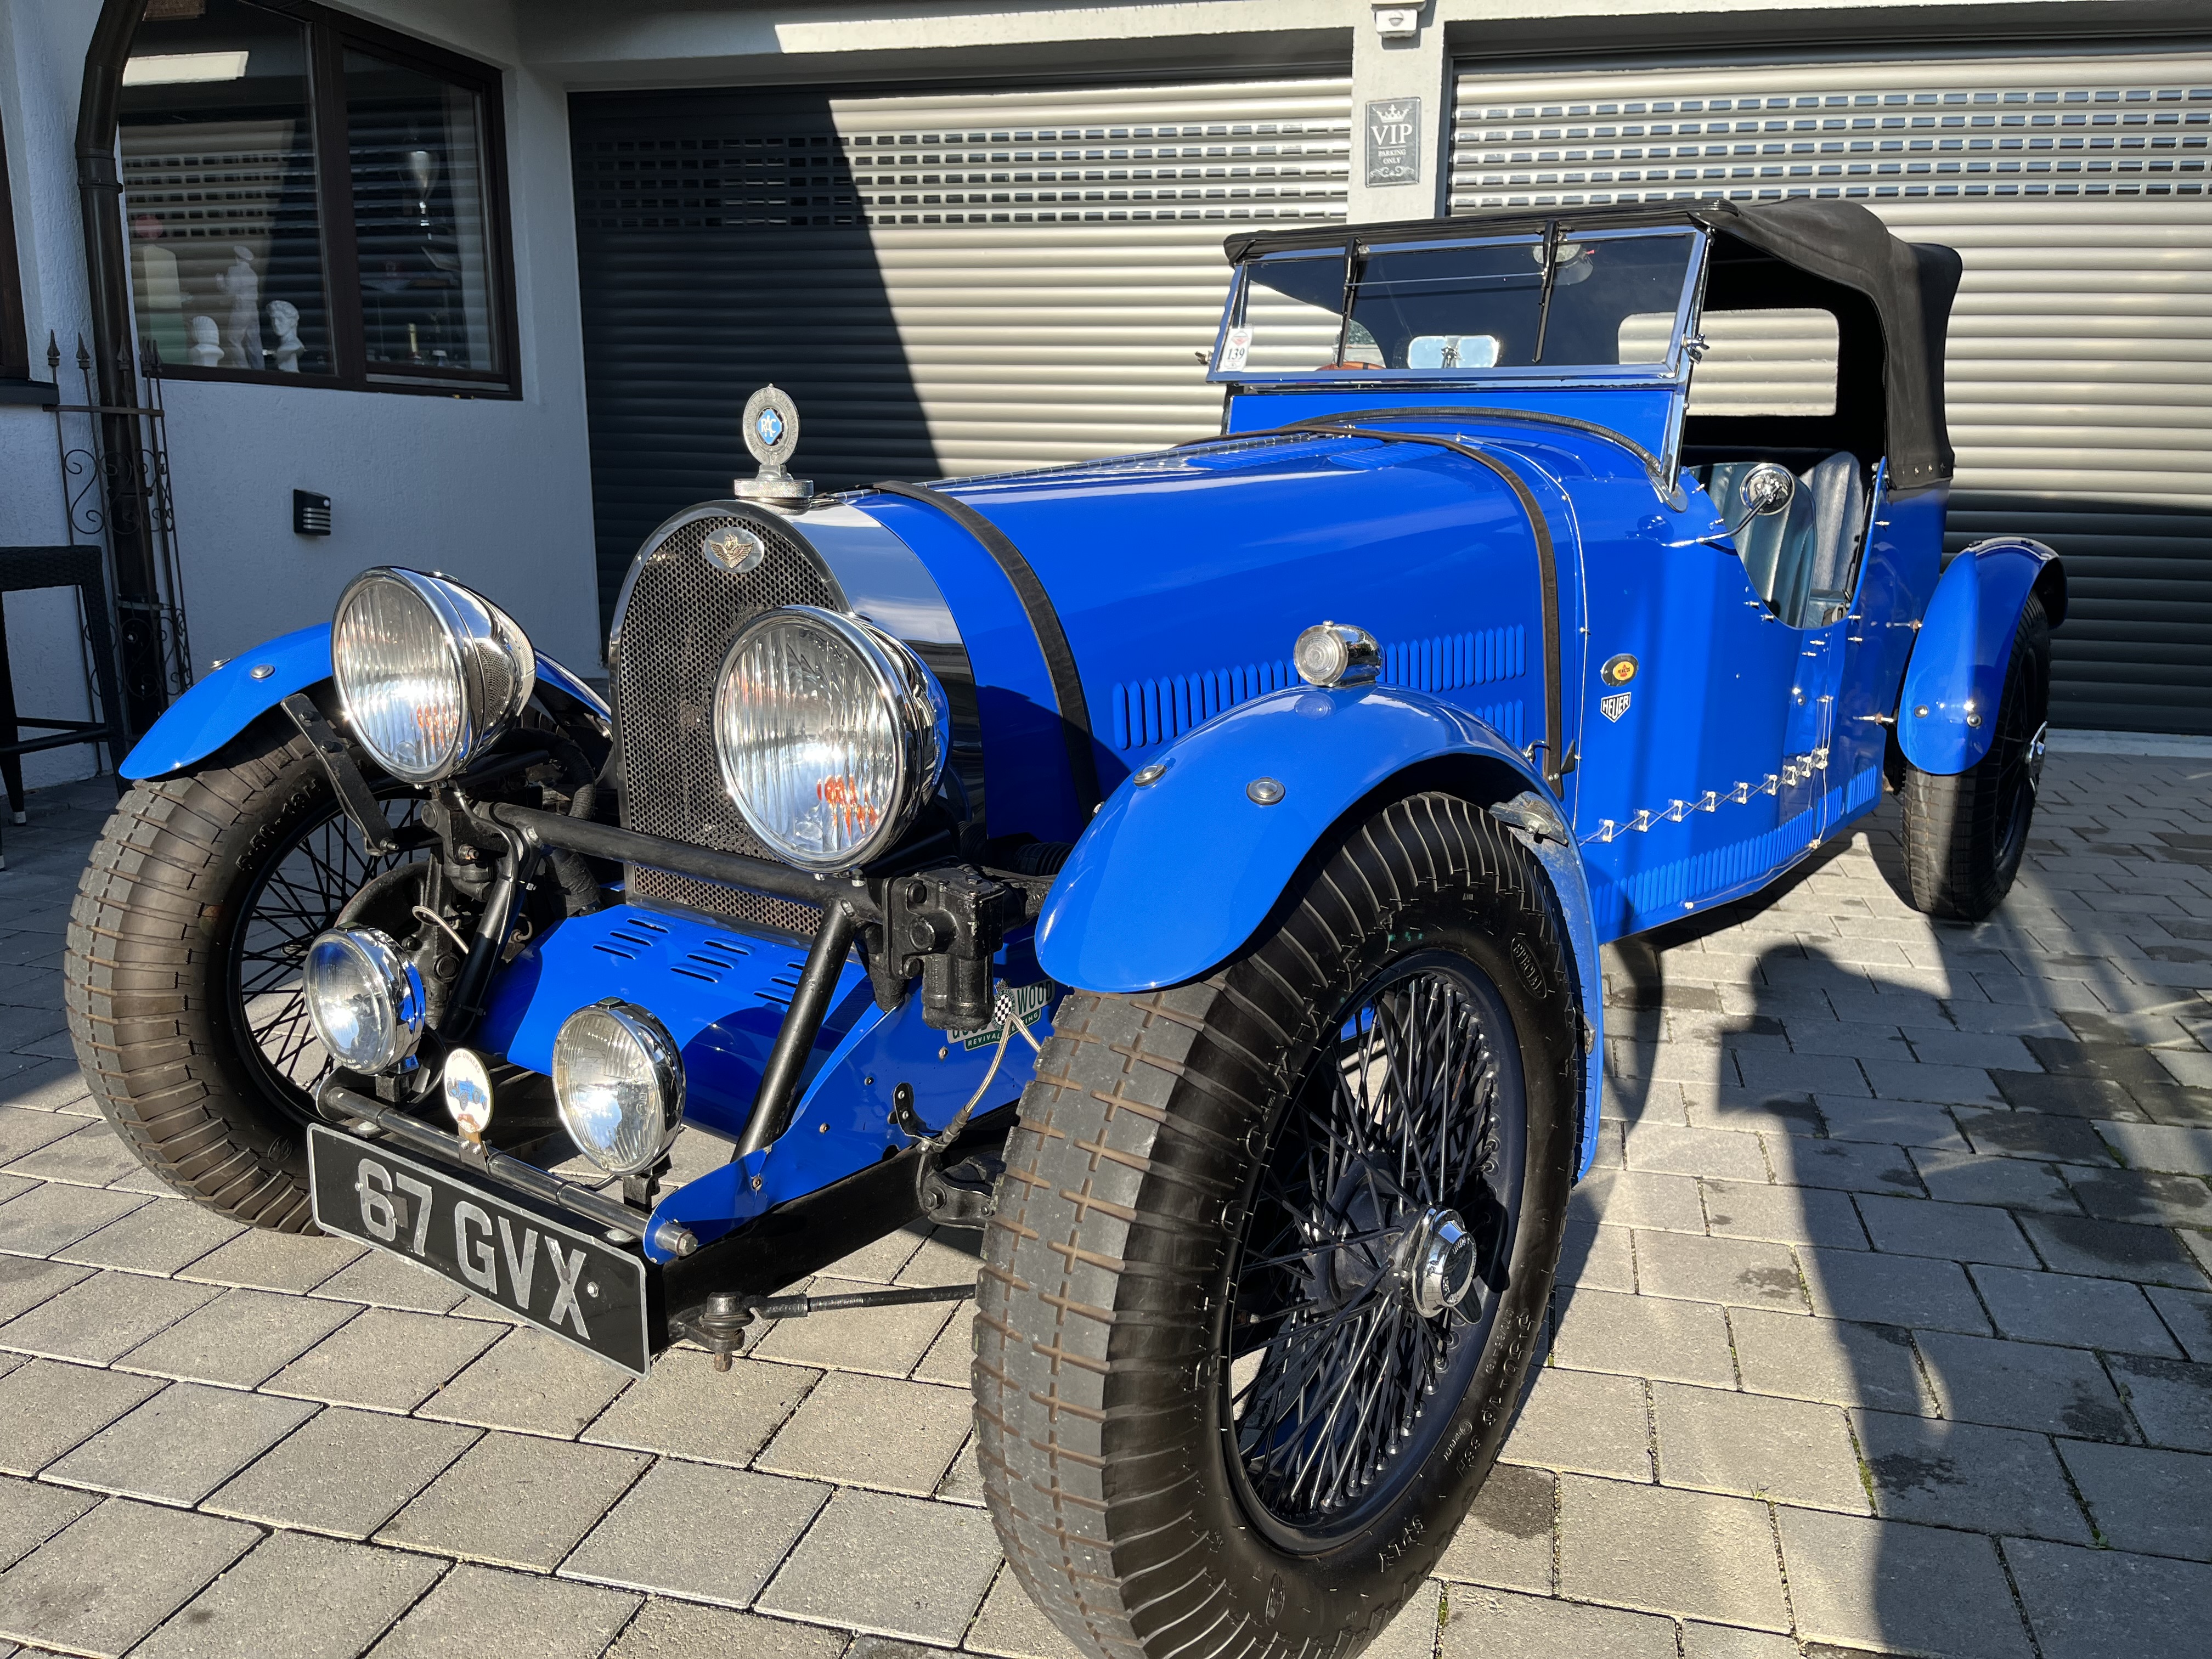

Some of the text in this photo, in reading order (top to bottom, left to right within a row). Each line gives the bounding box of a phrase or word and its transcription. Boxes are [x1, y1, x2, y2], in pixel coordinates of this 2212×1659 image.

[1370, 123, 1413, 145] VIP
[1378, 149, 1406, 157] PARKING
[1227, 348, 1245, 360] 139
[761, 415, 776, 437] RAC
[1602, 695, 1629, 719] HEUER
[1513, 943, 1543, 990] SPECIAL
[1017, 980, 1052, 1014] WOOD
[968, 1032, 1001, 1046] REVIVAL
[452, 1052, 481, 1074] TEAL OWNERS
[358, 1158, 591, 1340] 67 GVX
